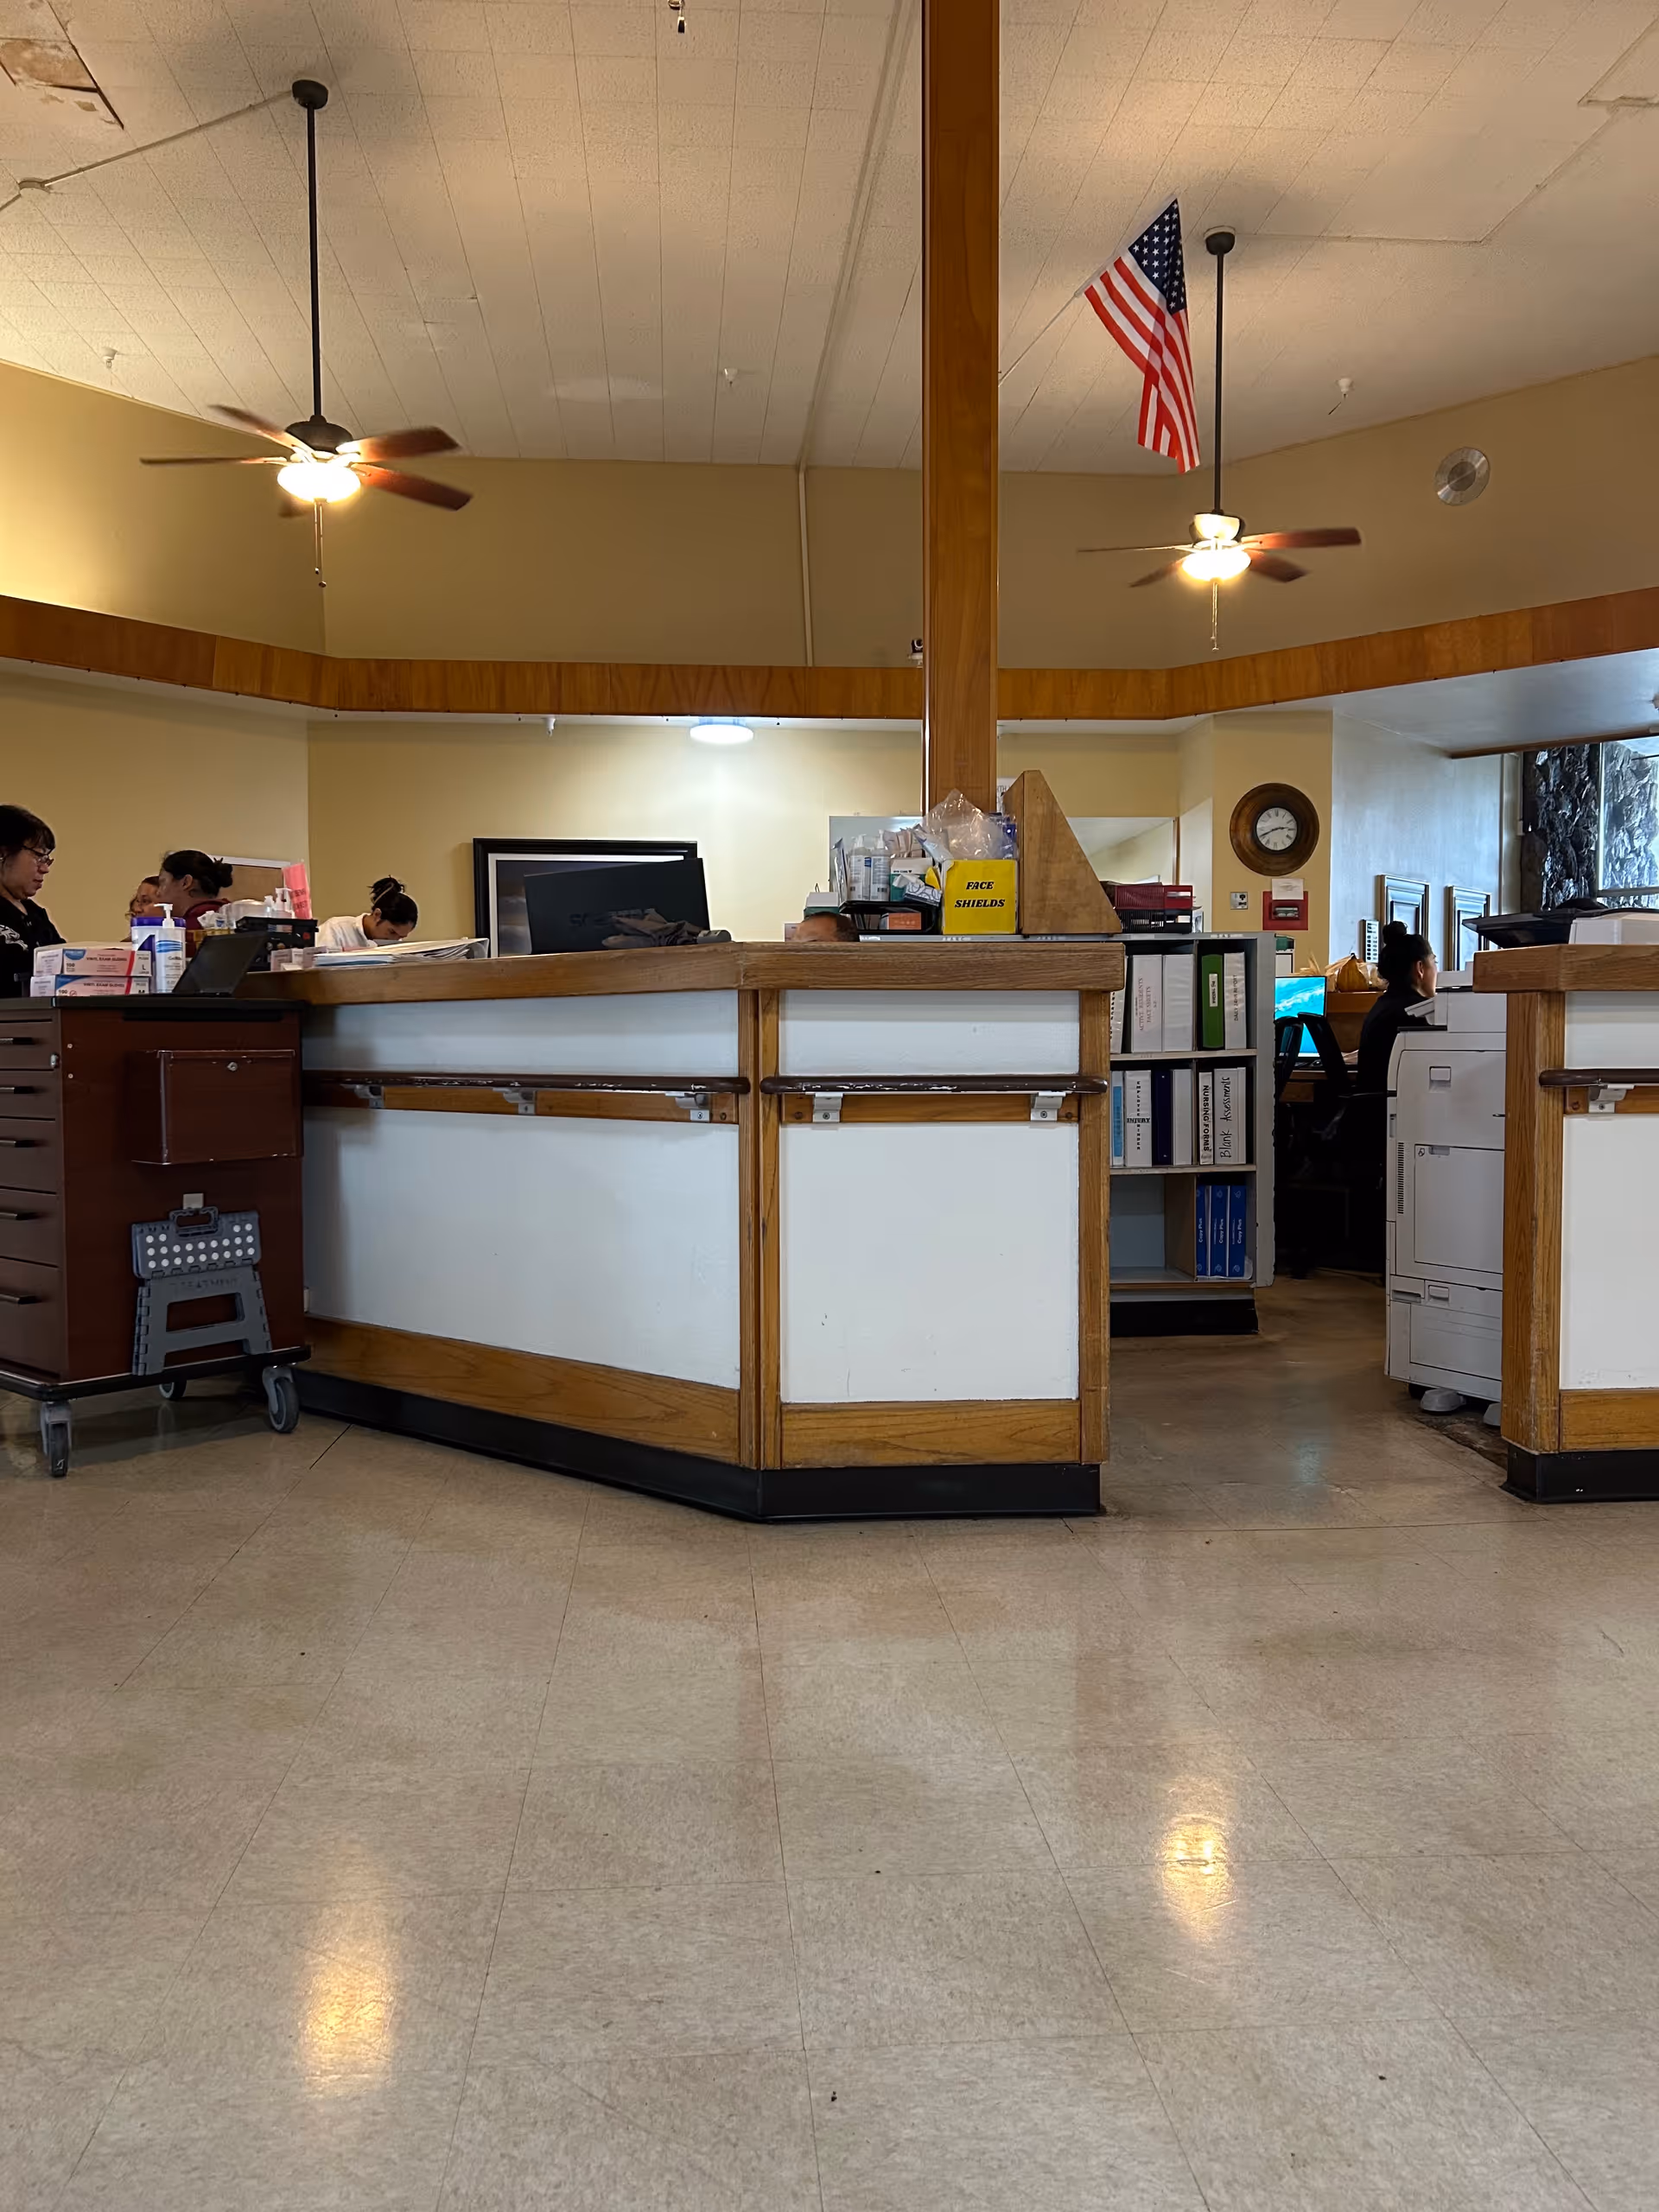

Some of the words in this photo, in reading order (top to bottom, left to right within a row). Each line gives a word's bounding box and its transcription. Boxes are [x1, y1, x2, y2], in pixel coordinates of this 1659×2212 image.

[965, 880, 995, 890] FACE
[954, 899, 1006, 908] SHIELDS
[1219, 1077, 1232, 1122] Assessments
[1218, 1129, 1232, 1158] Blank
